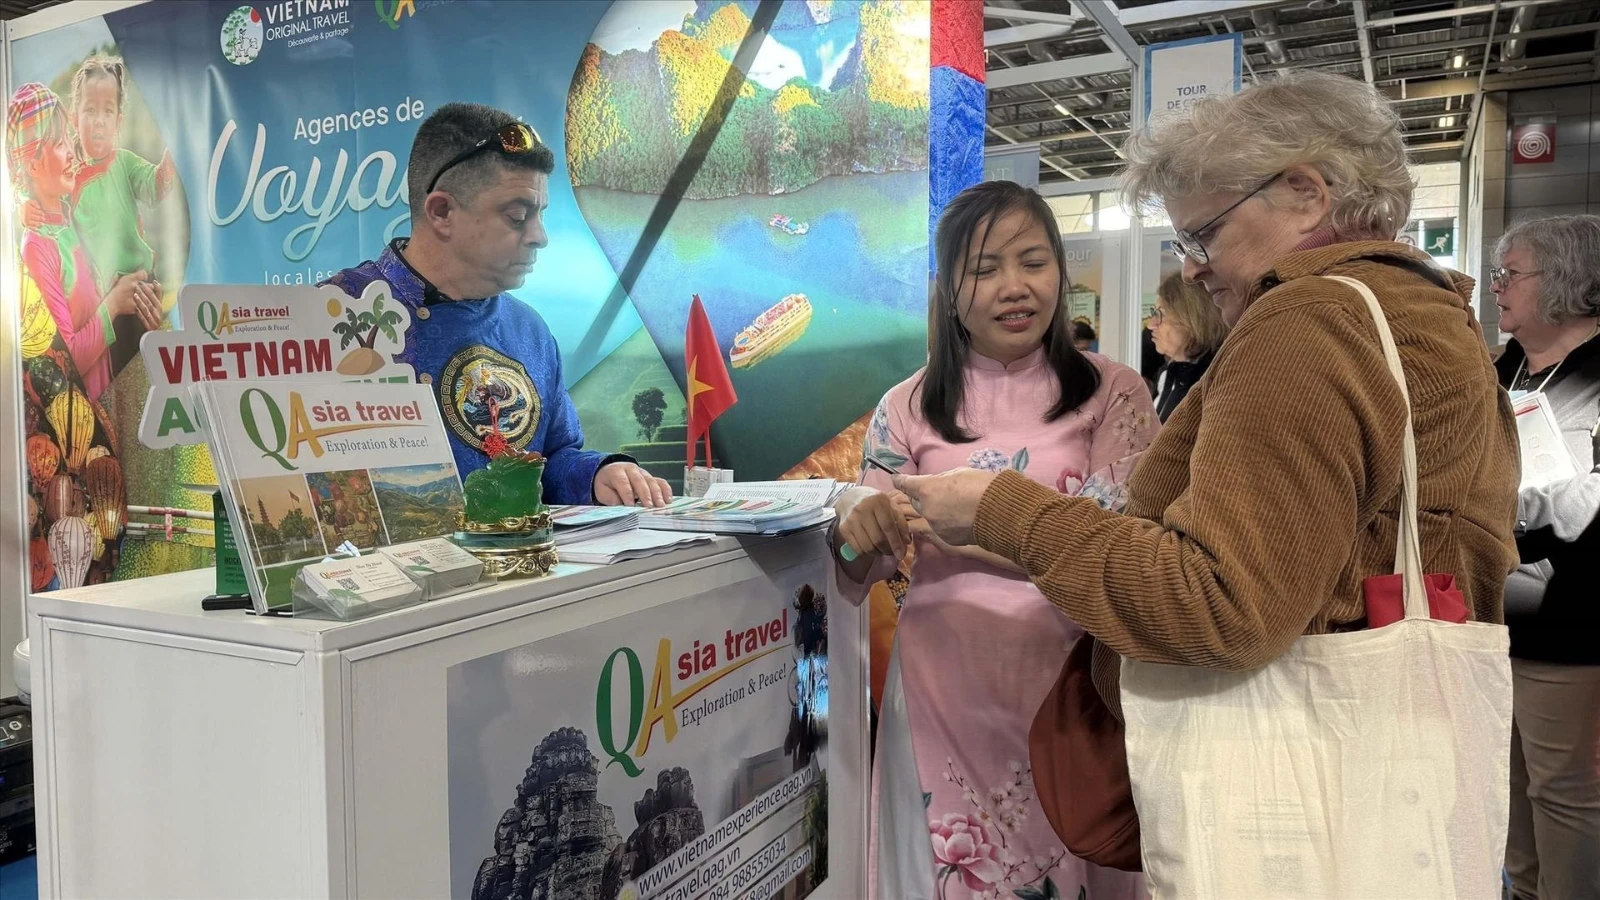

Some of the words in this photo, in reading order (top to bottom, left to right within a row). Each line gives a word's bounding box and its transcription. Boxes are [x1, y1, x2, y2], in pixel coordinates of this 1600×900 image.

[266, 20, 312, 41] ORIGINAL
[312, 11, 350, 29] TRAVEL
[288, 33, 319, 48] Découverte
[320, 31, 325, 40] &
[325, 28, 349, 40] partage
[1167, 100, 1181, 110] DE
[1177, 85, 1207, 97] TOUR
[294, 104, 389, 144] Agences
[396, 96, 425, 122] de
[207, 119, 412, 262] Voya
[254, 305, 290, 318] travel
[234, 324, 266, 333] Exploration
[273, 324, 290, 332] Peace!
[158, 338, 333, 385] VIETNAM
[356, 400, 423, 422] travel
[325, 437, 388, 455] Exploration
[389, 437, 398, 449] &
[400, 436, 429, 450] Peace!
[724, 608, 788, 661] travel
[680, 685, 745, 728] Exploration
[747, 678, 756, 695] &
[758, 663, 787, 690] Peace!
[638, 766, 814, 896] www.vietnamexperience.qag.vn
[732, 837, 787, 893] 988555034
